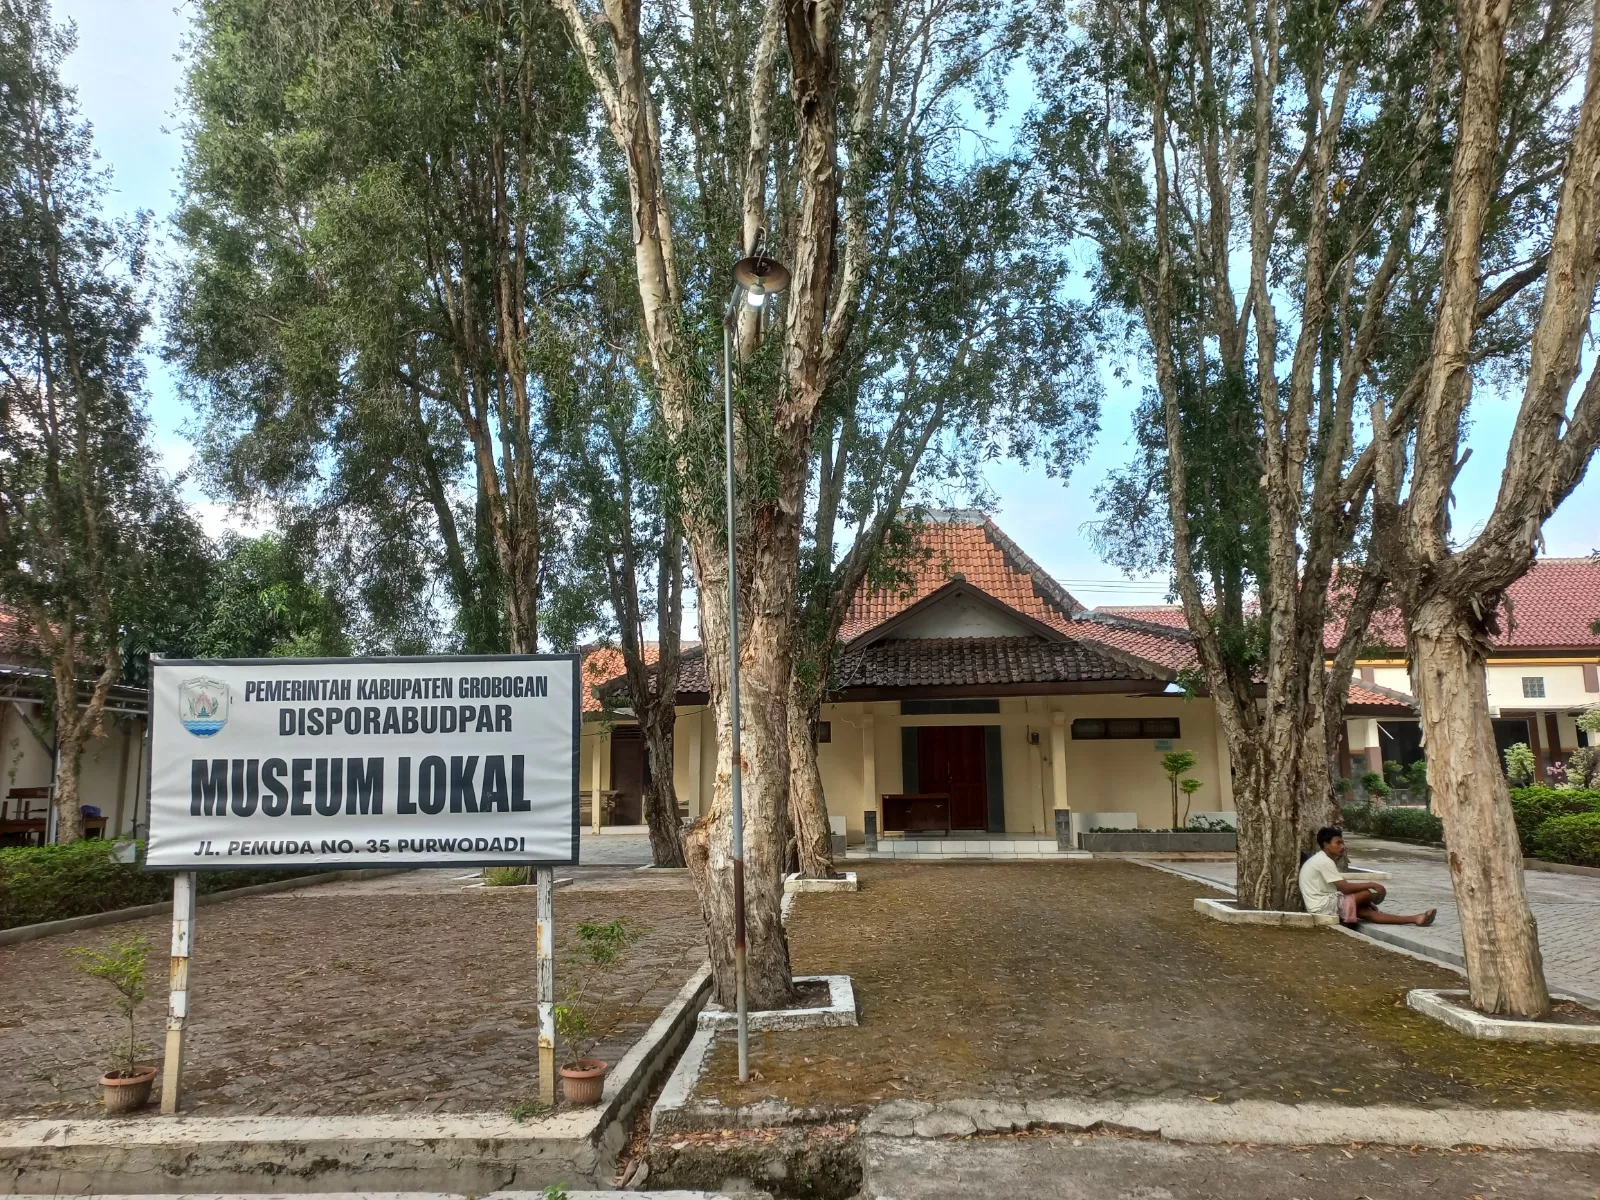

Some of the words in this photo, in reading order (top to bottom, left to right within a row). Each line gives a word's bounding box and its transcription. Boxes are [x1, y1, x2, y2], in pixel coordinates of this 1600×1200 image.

[245, 680, 351, 701] PEMERINTAH
[357, 678, 452, 700] KABUPATEN
[459, 676, 547, 698] GROBOGAN
[280, 705, 512, 735] DISPORABUDPAR
[191, 757, 384, 817] MUSEUM
[397, 755, 531, 815] LOKAL
[194, 841, 220, 856] JL.
[228, 841, 314, 855] PEMUDA
[321, 840, 359, 853] NO.
[366, 839, 390, 853] 35
[398, 837, 525, 852] PURWODADI
